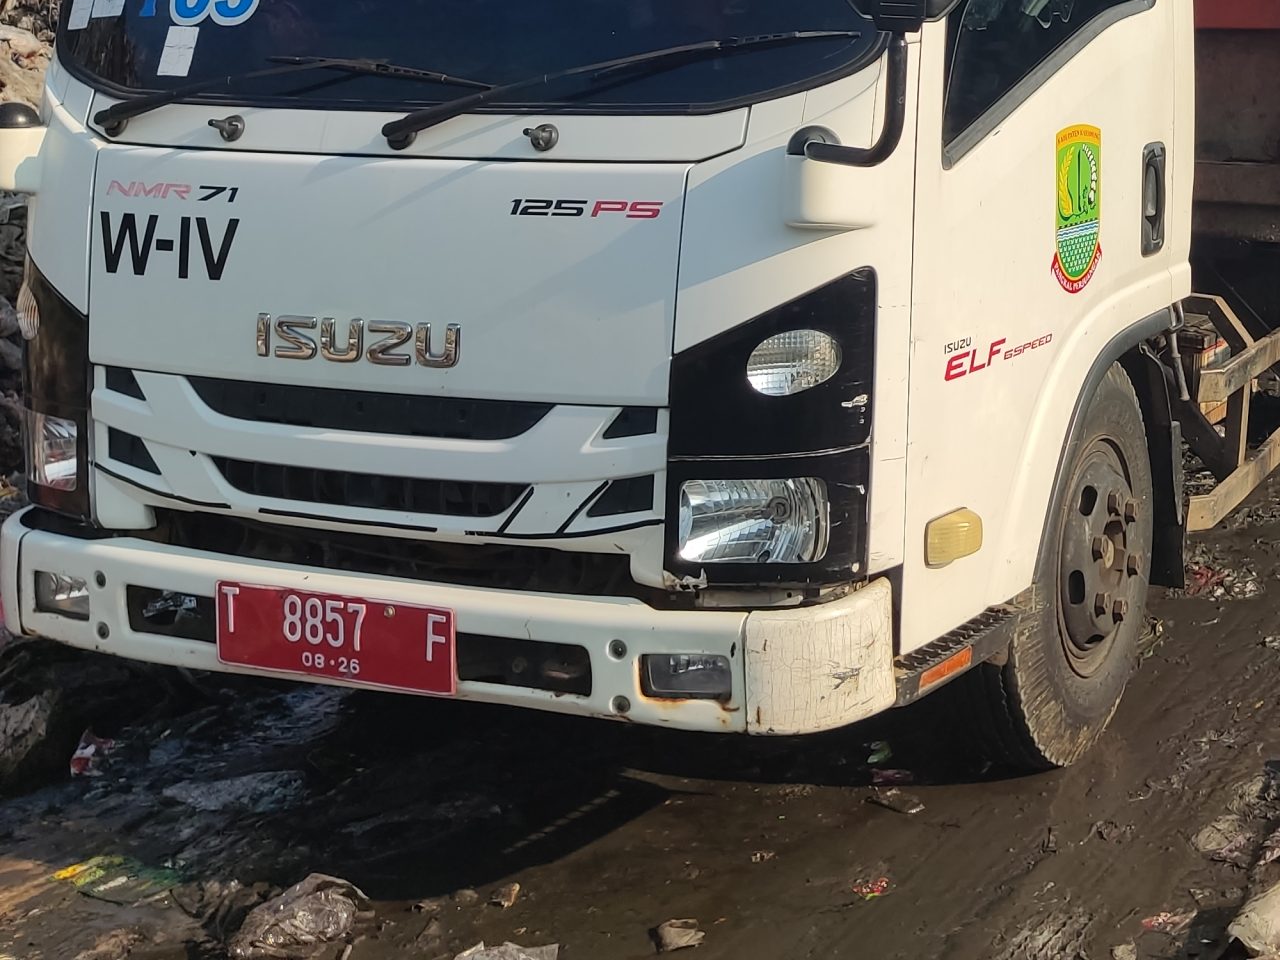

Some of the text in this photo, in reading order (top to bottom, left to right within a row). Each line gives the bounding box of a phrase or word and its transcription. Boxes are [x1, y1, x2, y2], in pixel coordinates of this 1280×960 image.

[106, 180, 239, 203] NMR 71
[510, 198, 664, 219] 125 PS
[100, 210, 240, 281] W-IV
[256, 312, 461, 369] ISUZU
[944, 336, 972, 355] ISUZU
[944, 337, 1007, 382] ELF
[222, 586, 446, 662] T 8857 F
